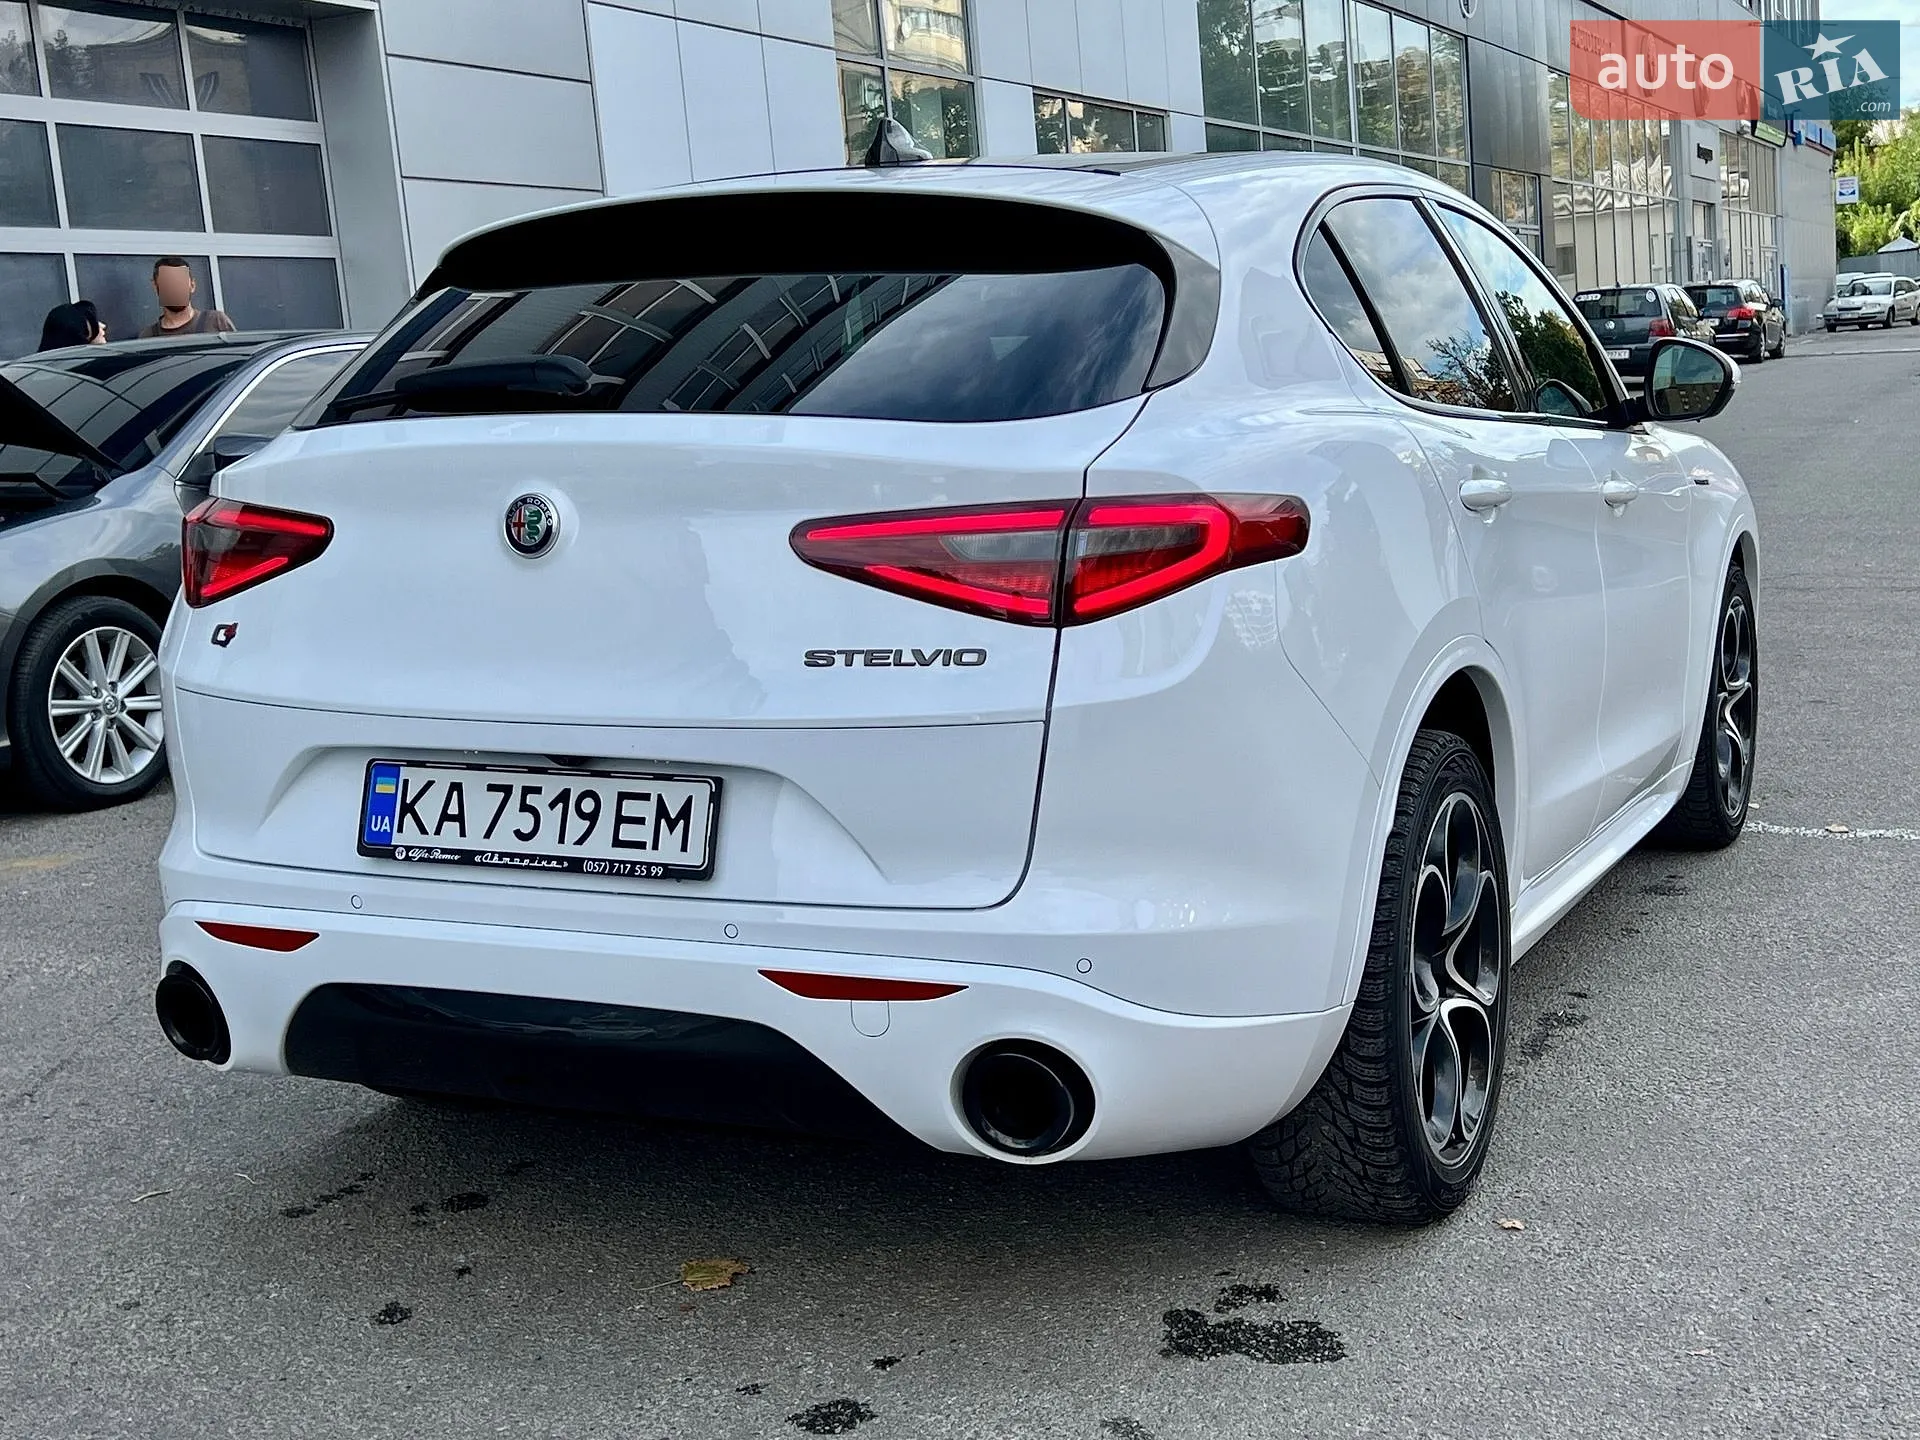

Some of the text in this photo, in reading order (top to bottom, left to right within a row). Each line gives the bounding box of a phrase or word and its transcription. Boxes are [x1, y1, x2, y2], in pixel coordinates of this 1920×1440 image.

[527, 498, 553, 526] ROMEO
[804, 648, 987, 667] STELVIO
[371, 814, 391, 833] UA
[396, 778, 693, 853] KA 7519 EM
[408, 848, 461, 861] Alfa Romeo
[583, 859, 664, 877] (057) 717 55 99
